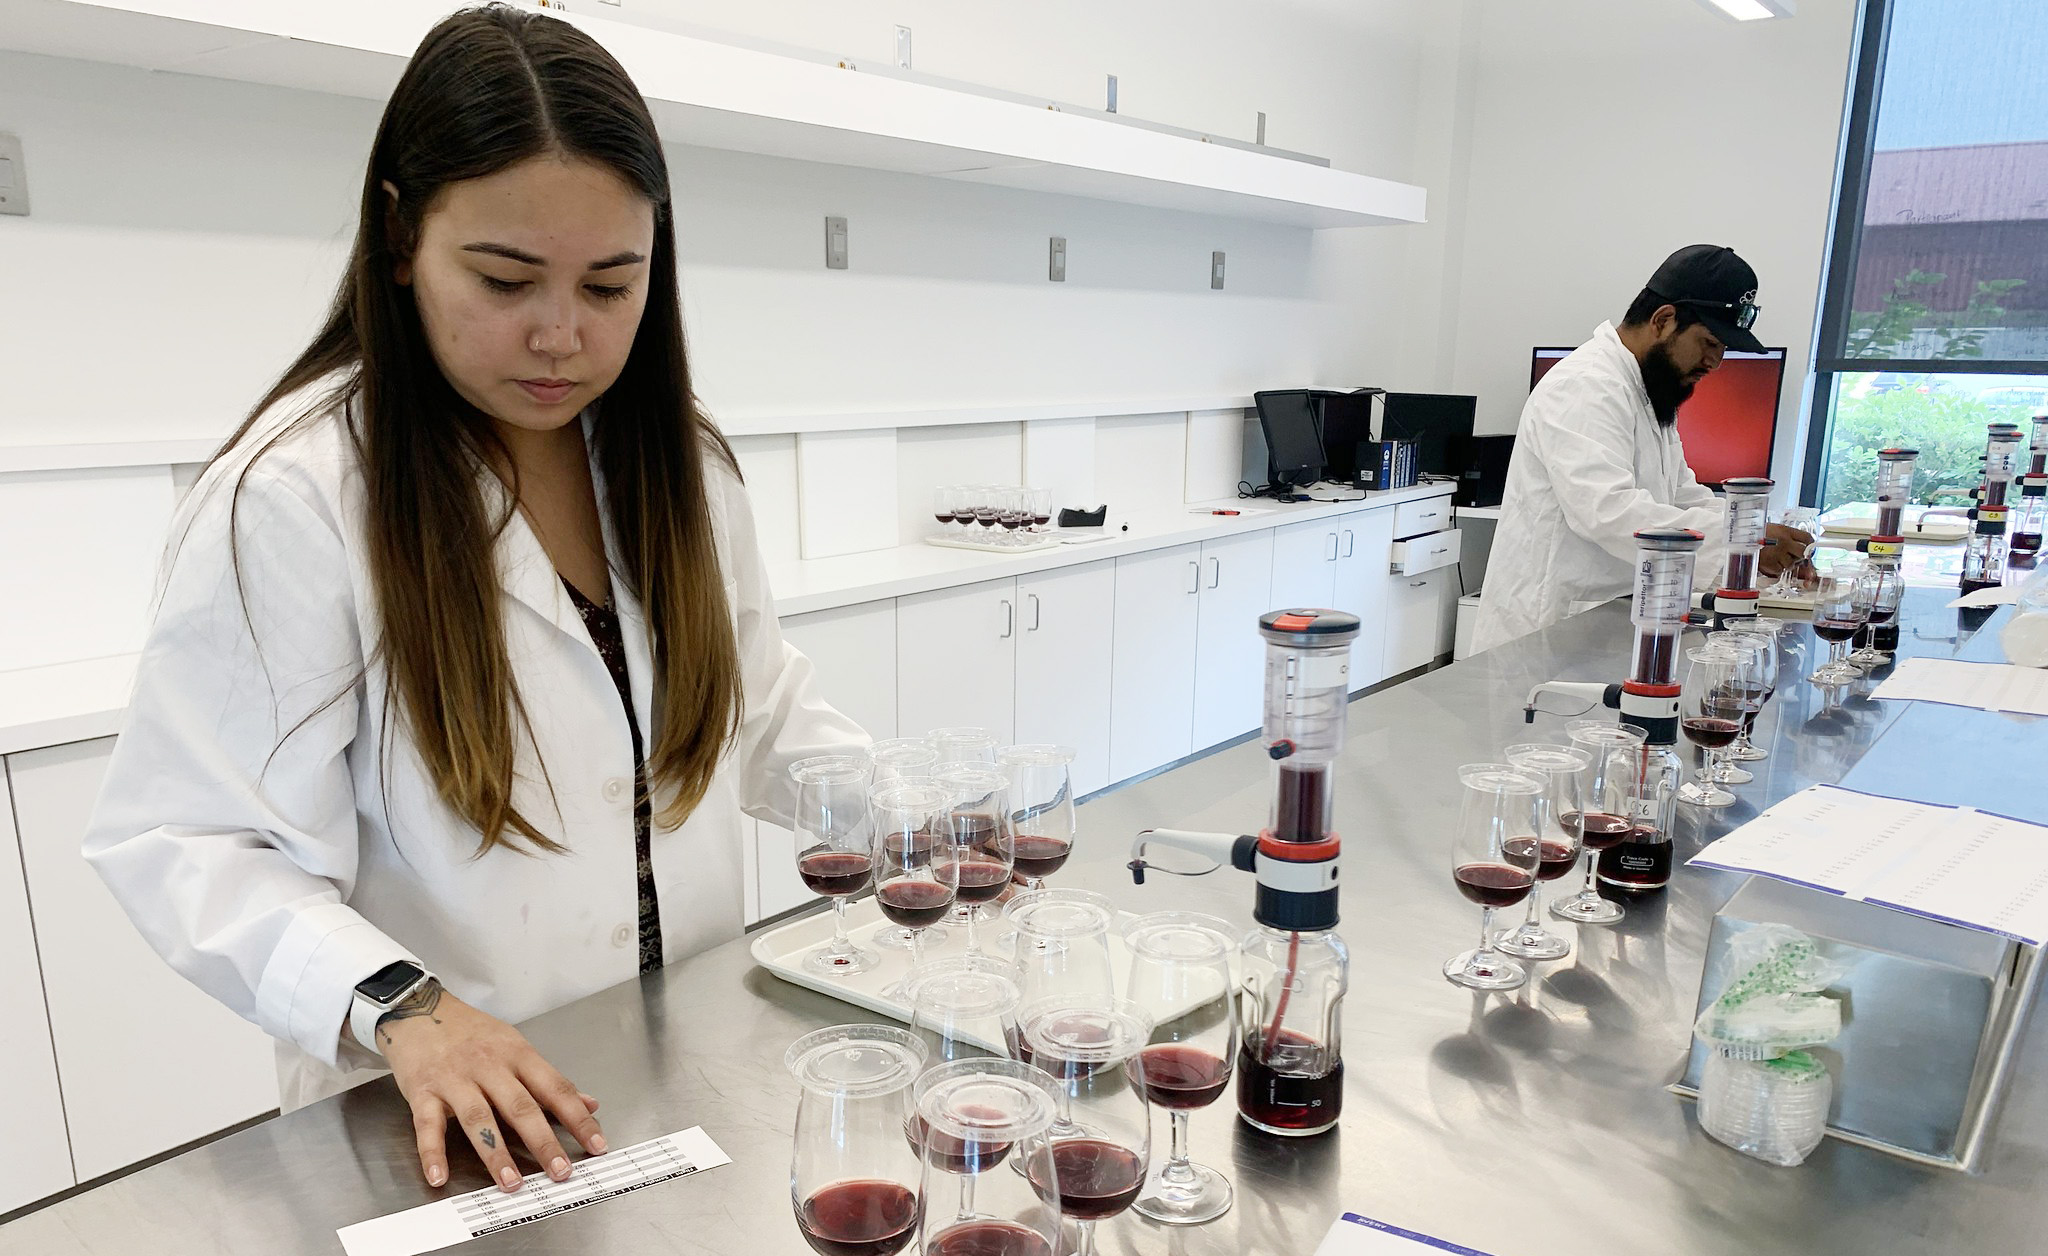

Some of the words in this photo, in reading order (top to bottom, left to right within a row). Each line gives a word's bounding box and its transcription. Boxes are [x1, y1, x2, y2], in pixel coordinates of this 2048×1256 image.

[1309, 1072, 1323, 1080] 100
[1311, 1099, 1322, 1107] 50
[675, 1167, 694, 1176] Flight
[644, 1175, 670, 1186] Sample
[589, 1192, 617, 1203] Position
[536, 1207, 566, 1218] Position
[482, 1222, 513, 1234] Position
[1356, 1217, 1387, 1229] AVERY
